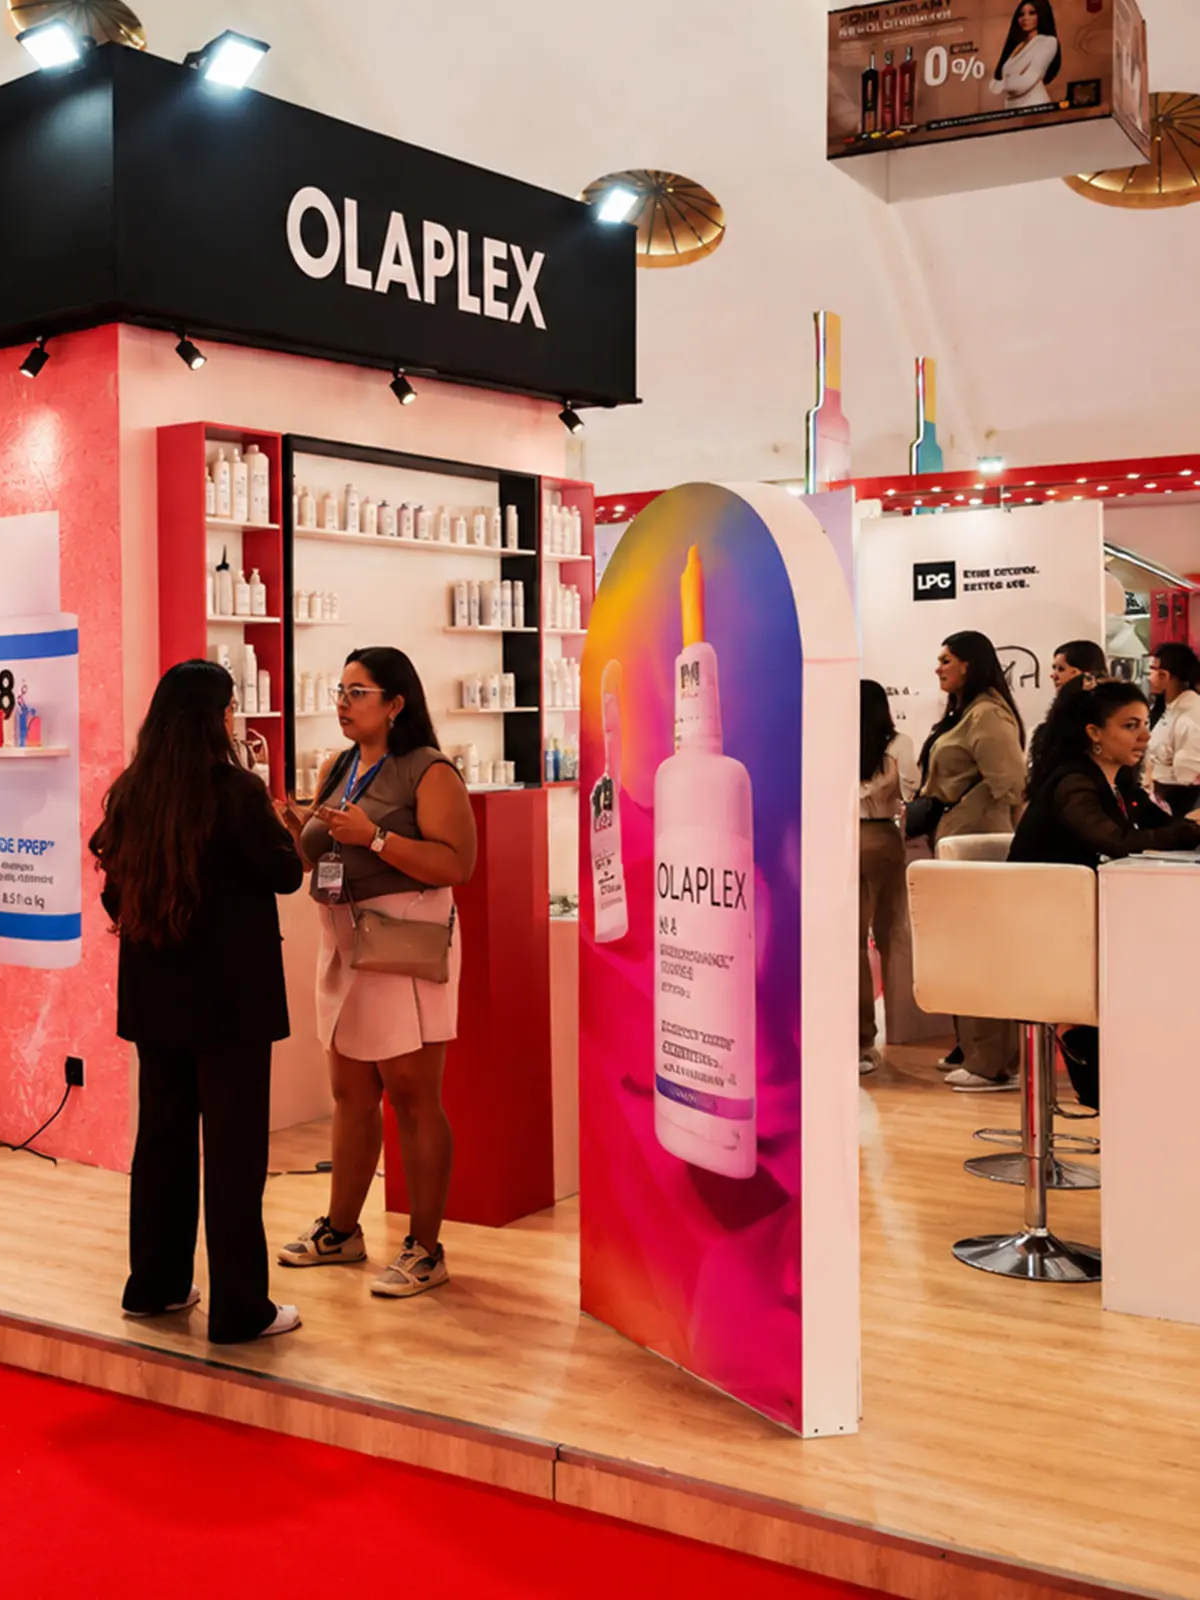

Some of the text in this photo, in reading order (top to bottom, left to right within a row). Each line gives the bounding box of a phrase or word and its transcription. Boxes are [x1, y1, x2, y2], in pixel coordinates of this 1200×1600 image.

[286, 186, 547, 330] OLAPLEX
[917, 573, 951, 590] LPG
[657, 862, 748, 911] OLAPLEX
